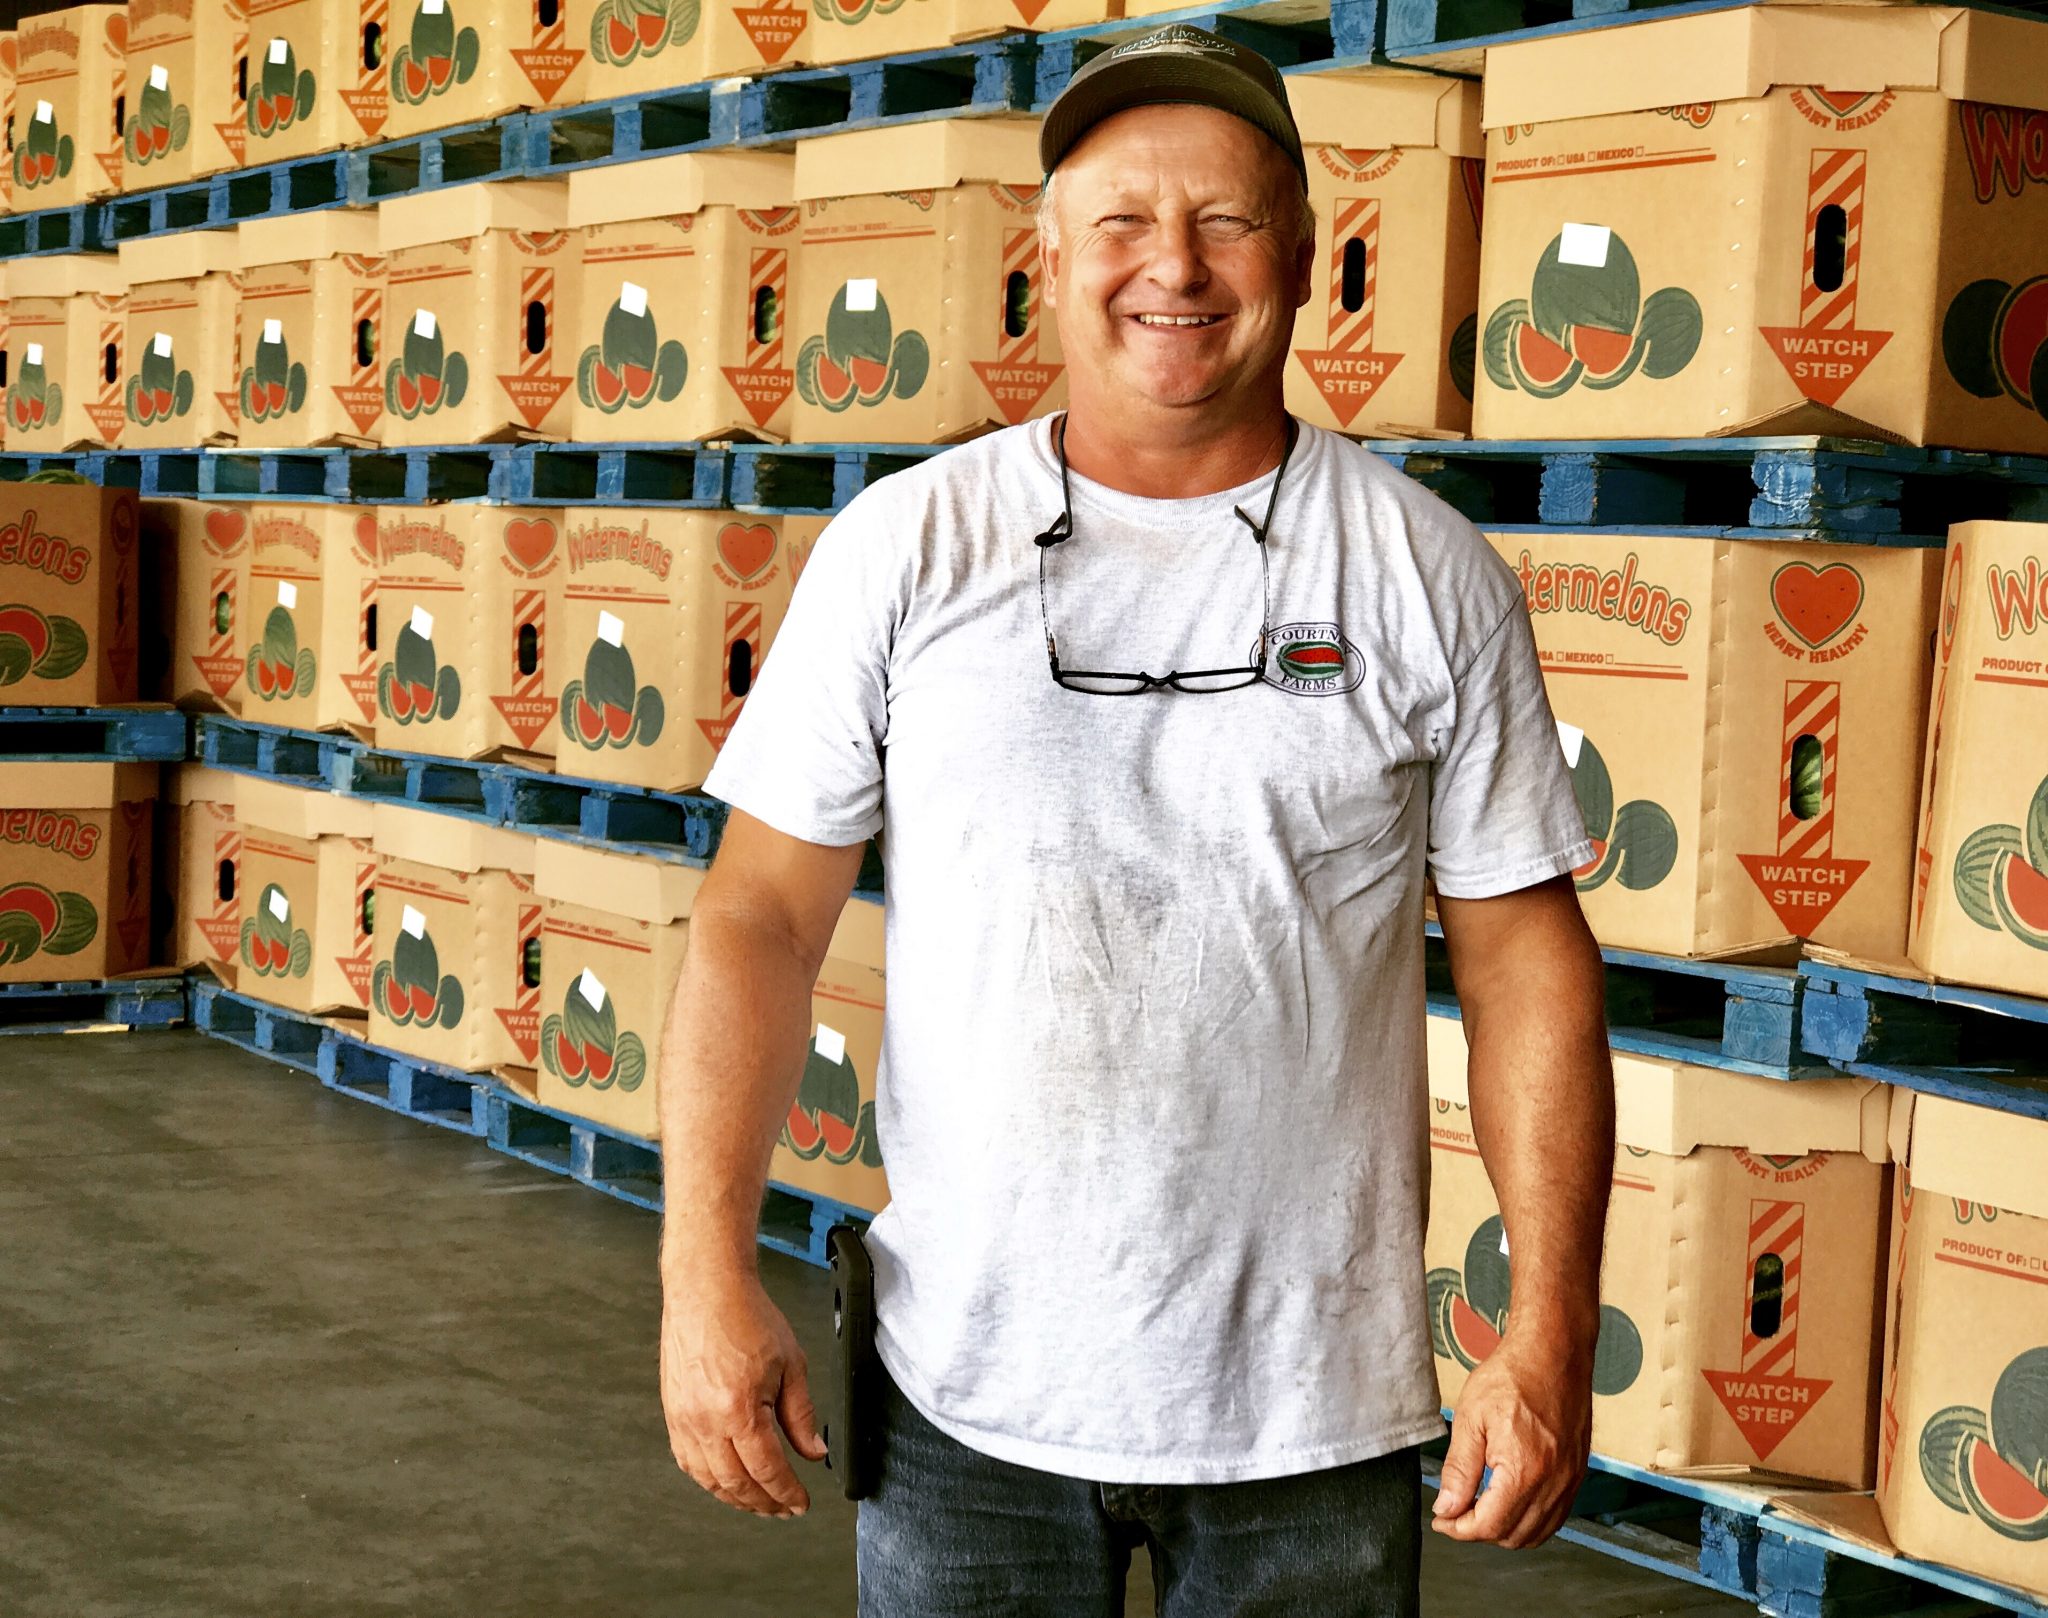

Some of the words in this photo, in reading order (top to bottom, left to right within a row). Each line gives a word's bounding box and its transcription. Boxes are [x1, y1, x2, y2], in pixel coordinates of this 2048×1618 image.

[747, 14, 803, 27] WATCH
[754, 30, 793, 43] STEP
[522, 54, 574, 66] WATCH
[530, 69, 565, 80] STEP
[350, 95, 388, 105] WATC
[1790, 89, 1832, 129] HEART
[1836, 88, 1897, 131] HEALTHY
[1315, 147, 1350, 182] HEART
[1496, 157, 1538, 172] PRODUCT
[1566, 152, 1585, 164] USA
[1596, 147, 1634, 162] MEXICO
[1783, 337, 1869, 356] WATCH
[1313, 358, 1384, 375] WATCH
[1795, 363, 1854, 379] STEP
[735, 374, 791, 387] WATCH
[985, 369, 1048, 383] WATCH
[510, 381, 560, 393] WATCH
[995, 387, 1038, 400] STEP
[1323, 380, 1373, 394] STEP
[342, 391, 386, 402] WATCH
[517, 395, 553, 407] STEP
[743, 390, 783, 402] STEP
[92, 408, 124, 417] WATC
[349, 404, 381, 415] STEP
[0, 509, 91, 585] elons
[567, 517, 674, 582] Watermelons
[1512, 549, 1692, 646] termelons
[1271, 629, 1346, 651] COURTN
[1763, 621, 1805, 662] HEART
[1809, 622, 1870, 664] HEALTHY
[1565, 652, 1604, 664] MEXICO
[1982, 657, 2042, 673] PRODUCT
[1280, 673, 1337, 690] FARMS
[503, 702, 552, 714] WATCH
[511, 716, 545, 727] STEP
[0, 808, 101, 861] elons
[1761, 865, 1847, 885] WATCH
[1773, 889, 1832, 906] STEP
[346, 963, 371, 973] WAT
[506, 1015, 539, 1026] WAT
[514, 1029, 539, 1040] STE
[1774, 1150, 1830, 1183] HEALTH
[1942, 1238, 2003, 1261] PRODUCT
[1724, 1381, 1809, 1403] WATCH
[1736, 1405, 1795, 1424] STEP
